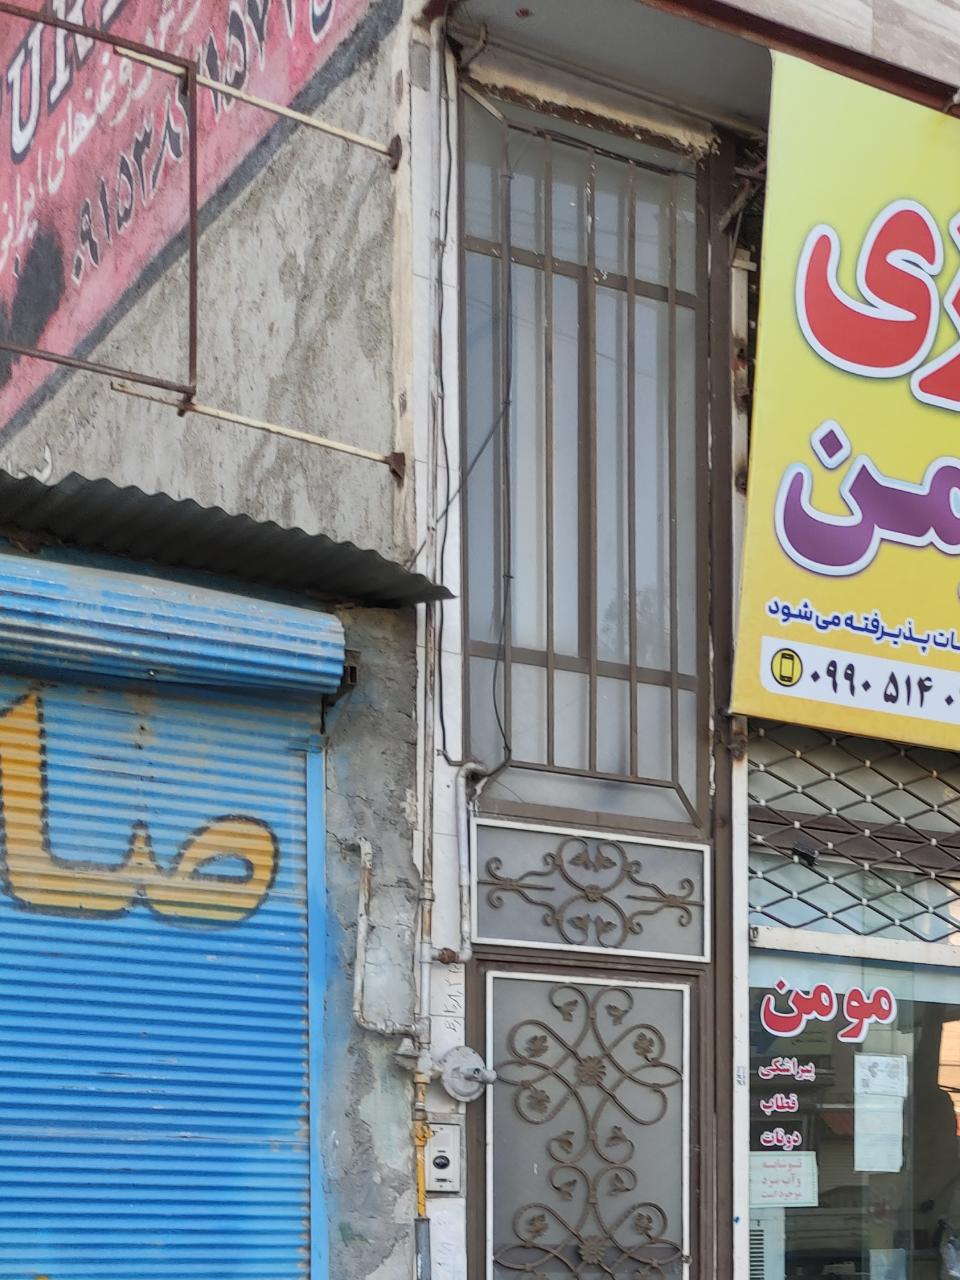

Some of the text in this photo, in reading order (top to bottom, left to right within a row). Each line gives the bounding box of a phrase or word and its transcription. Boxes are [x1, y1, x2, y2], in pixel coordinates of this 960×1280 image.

[844, 612, 930, 654] پذیرفته
[811, 659, 872, 697] ۰۹۹۰
[883, 671, 933, 708] ۵۱۴
